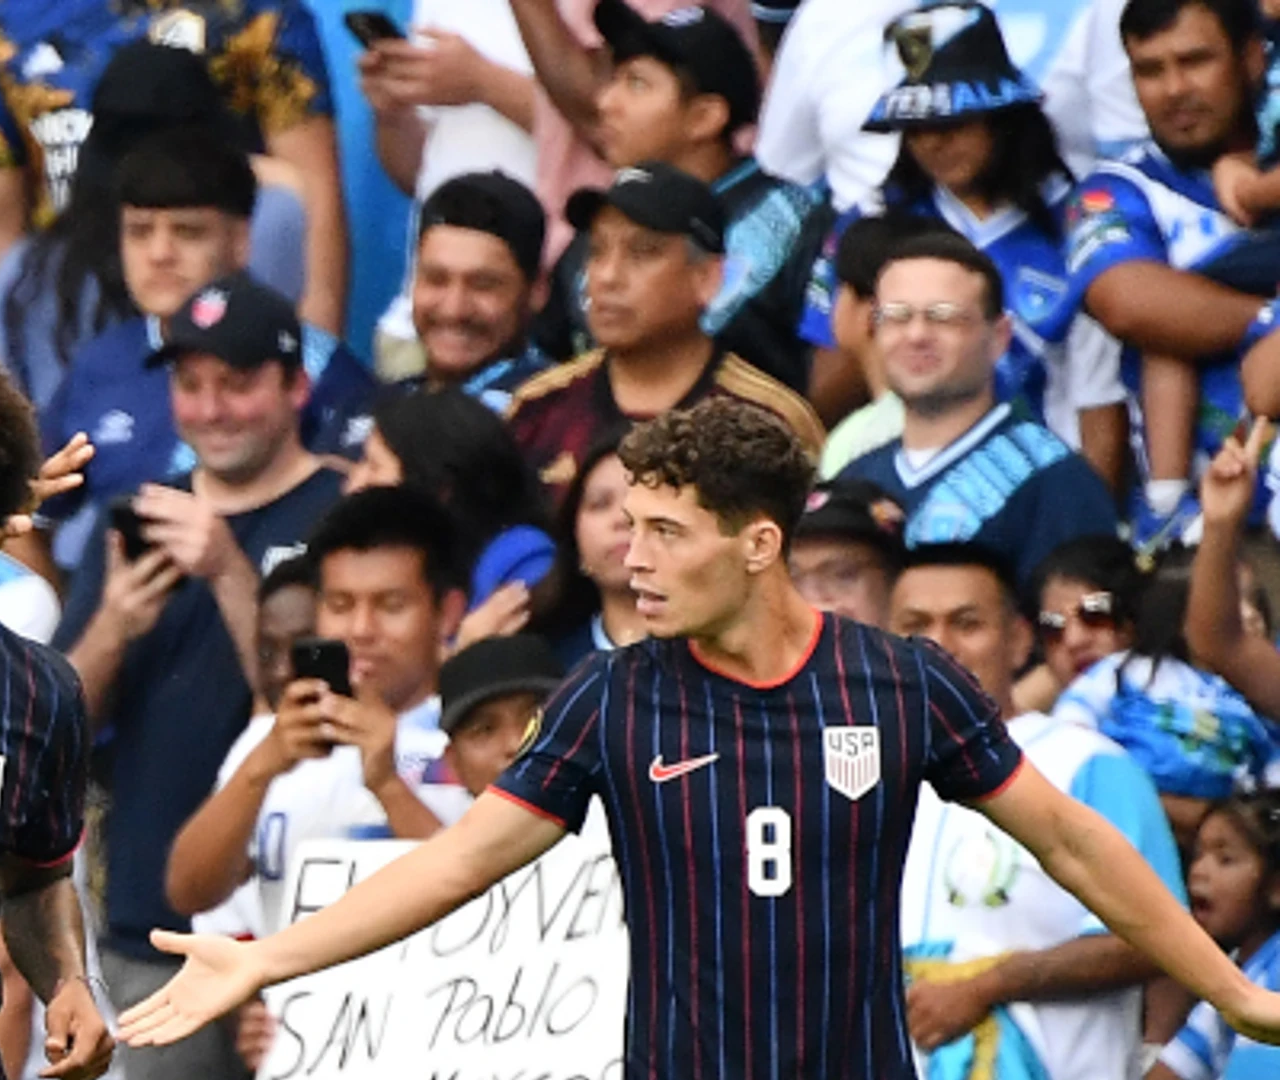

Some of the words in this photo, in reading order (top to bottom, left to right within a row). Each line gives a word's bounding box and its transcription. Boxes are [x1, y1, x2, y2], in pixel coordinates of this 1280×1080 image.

[828, 731, 875, 757] USA
[746, 806, 793, 897] 8
[426, 961, 598, 1051] Pablo
